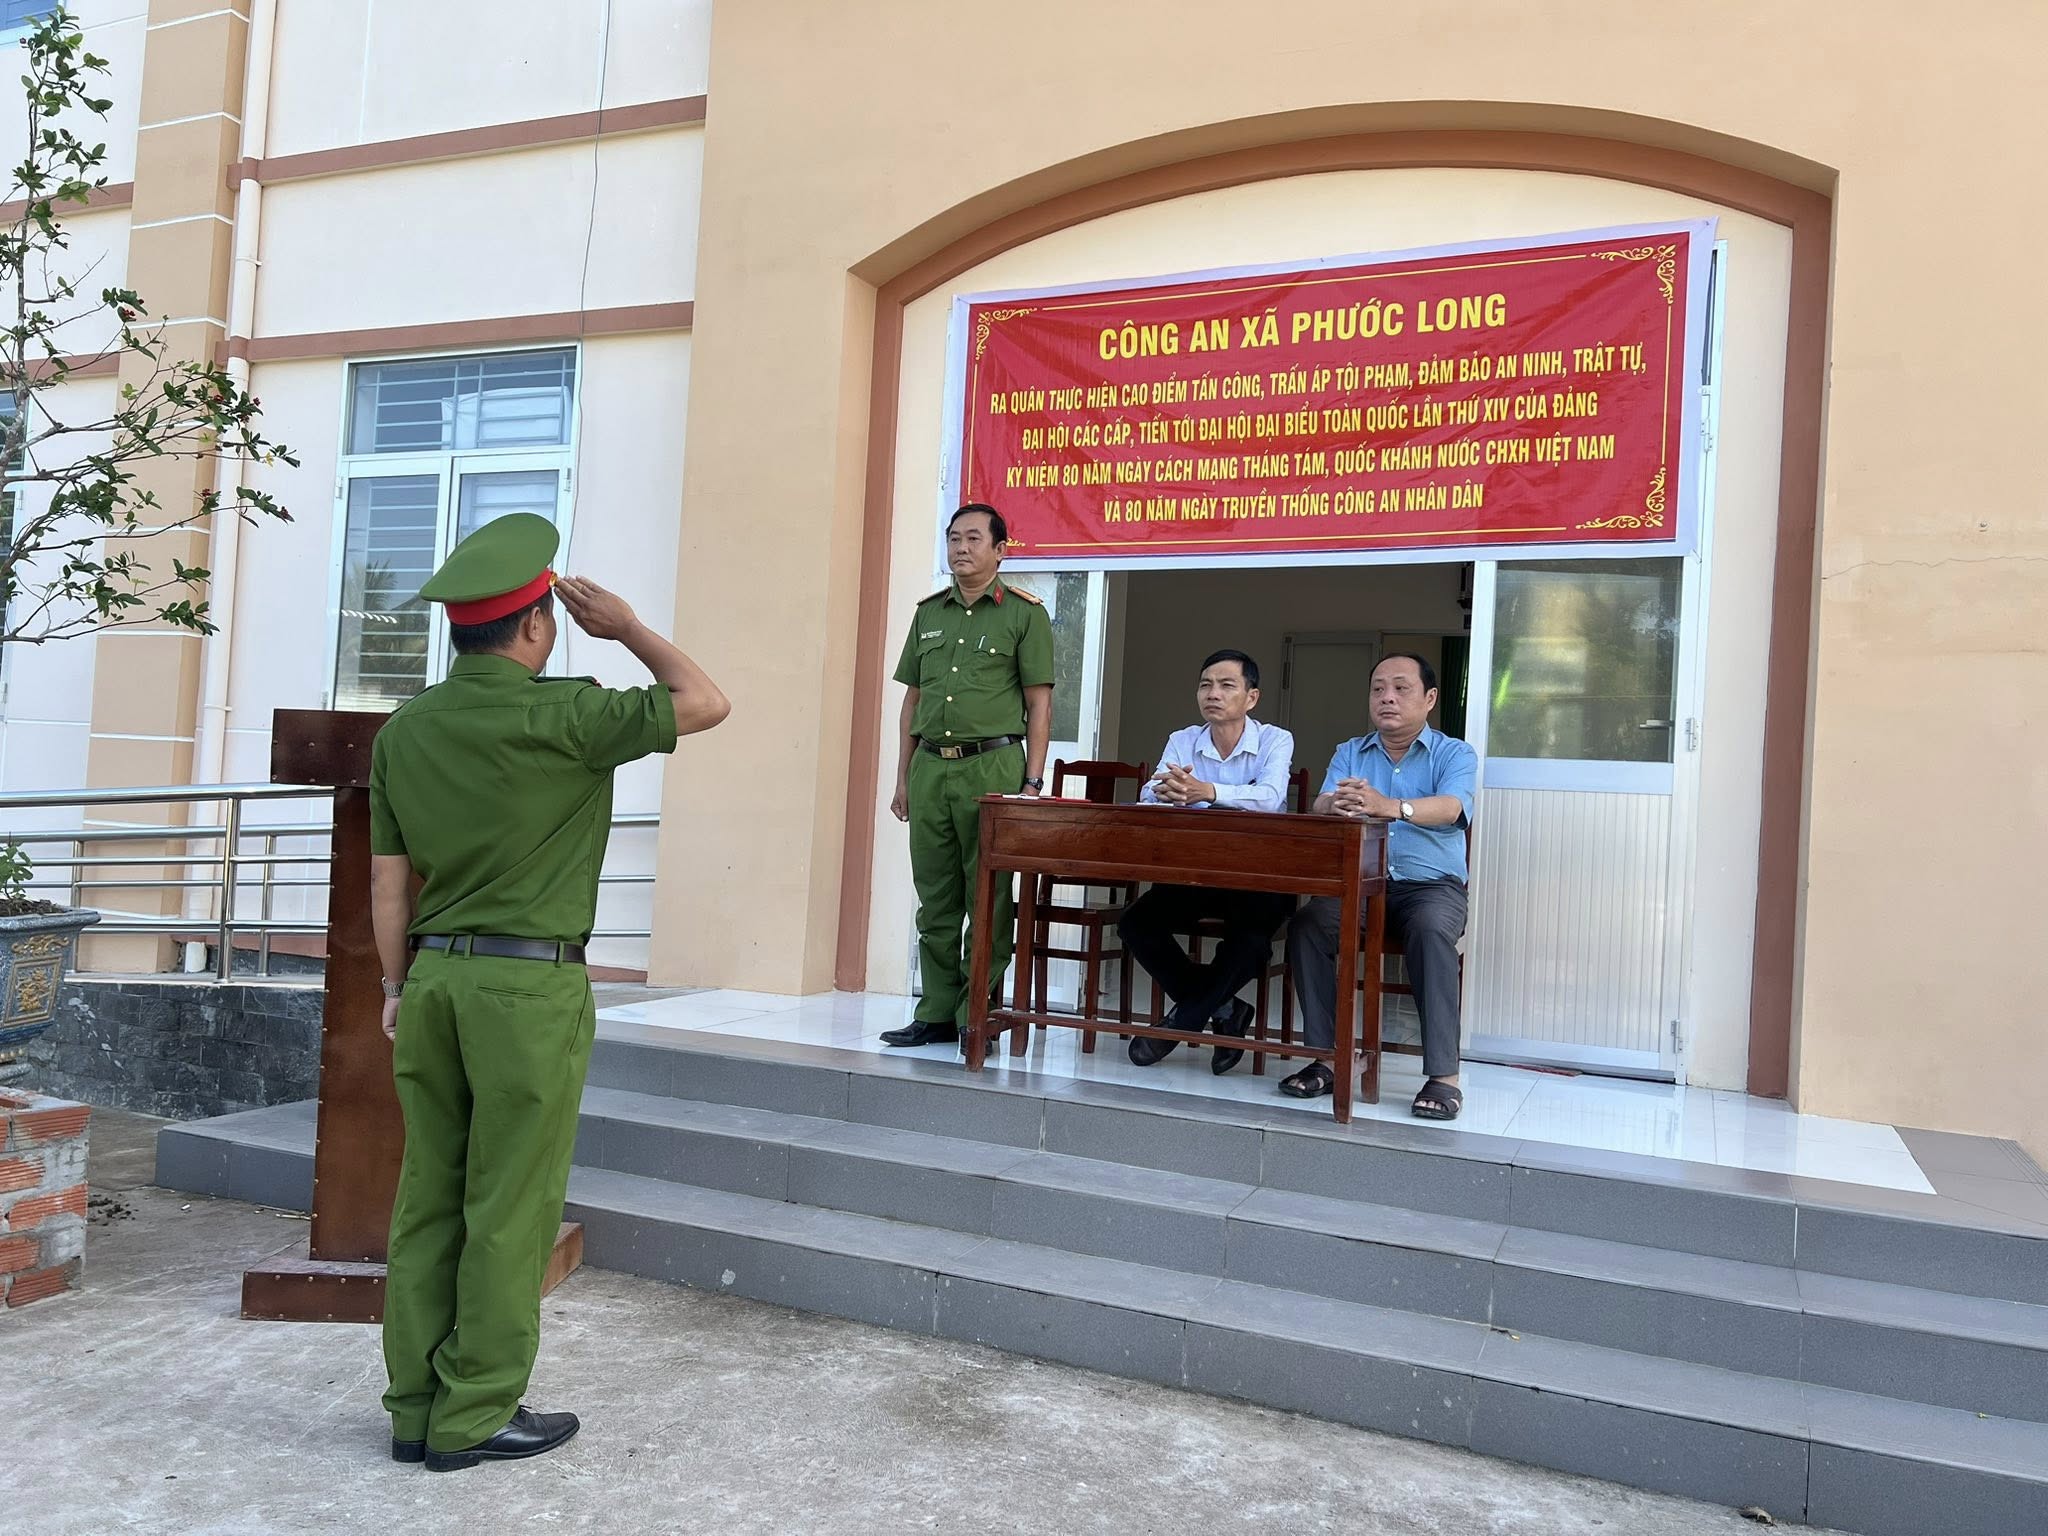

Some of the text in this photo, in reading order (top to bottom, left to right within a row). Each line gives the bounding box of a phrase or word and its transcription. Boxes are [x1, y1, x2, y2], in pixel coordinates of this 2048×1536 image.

[1099, 293, 1506, 361] CÔNG AN XÃ PHƯỚC LONG
[990, 340, 1647, 416] RA QUÂN THỰC HIỆN CAO ĐIỂM TẤN CÔNG, TRẤN ÁP TỘI PHẠM, ĐẢM BẢO AN NINH, TRẬT TỰ,
[1021, 385, 1598, 454] ĐẠI HỘI CÁC CẤP, TIẾN TỚI ĐẠI HỘI ĐẠI BIỂU TOÀN QUỐC LẦN THỨ XIV CỦA ĐẢNG
[1005, 431, 1615, 492] KỶ NIỆM 80 NĂM NGÀY CÁCH MẠNG THÁNG TÁM, QUỐC KHÁNH NƯỚC CHXH VIỆT NAM
[1103, 478, 1484, 523] VÀ 80 NĂM NGÀY TRUYỀN THỐNG CÔNG AN NHÂN DÂN
